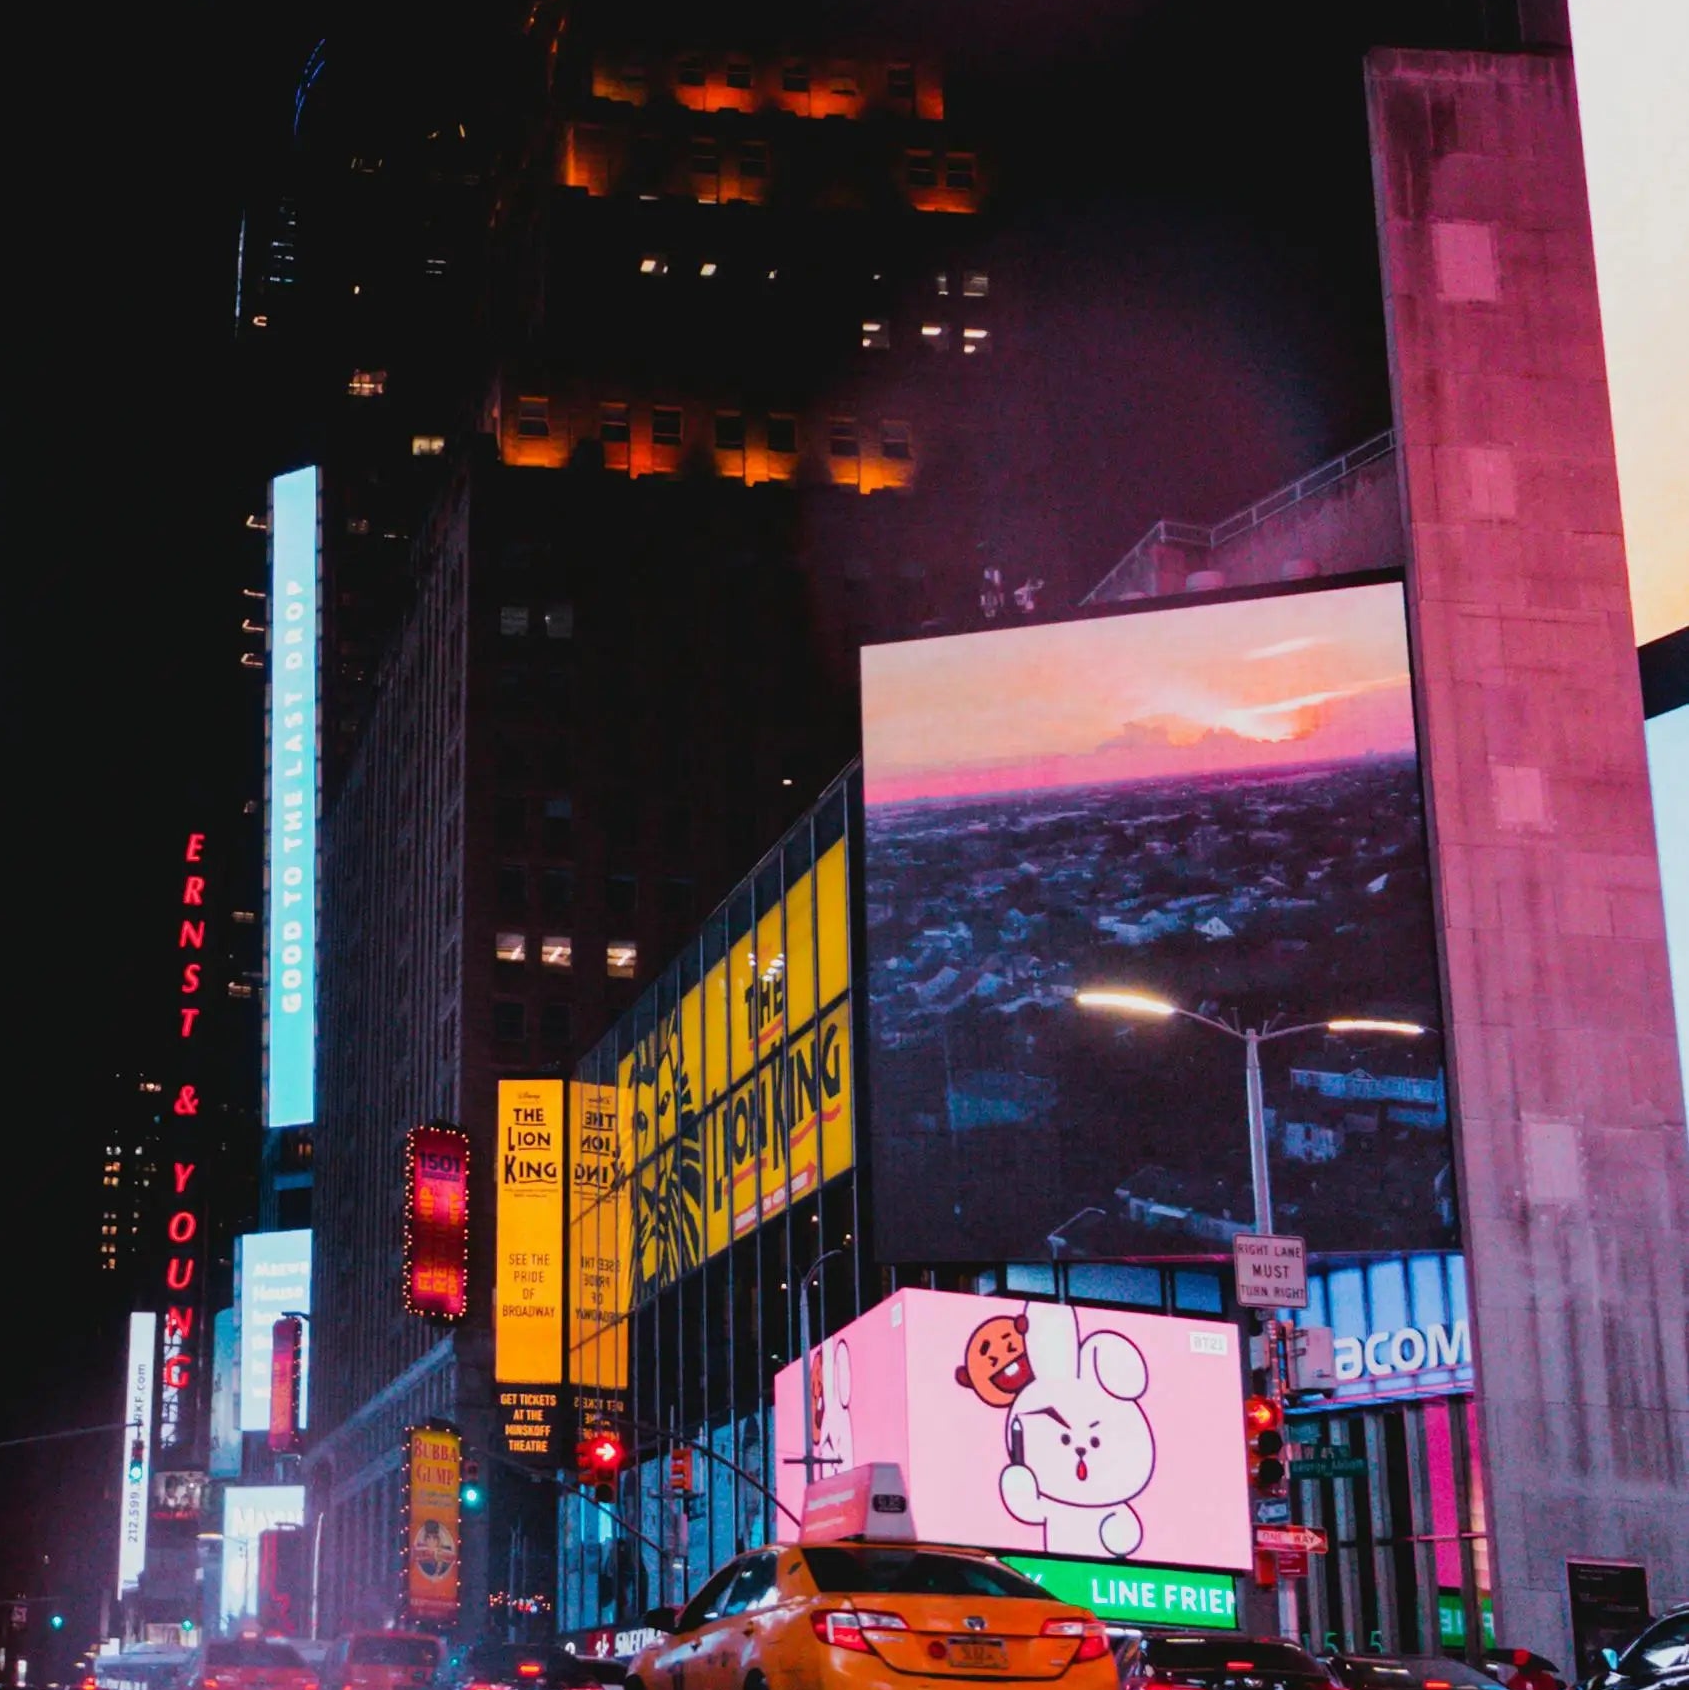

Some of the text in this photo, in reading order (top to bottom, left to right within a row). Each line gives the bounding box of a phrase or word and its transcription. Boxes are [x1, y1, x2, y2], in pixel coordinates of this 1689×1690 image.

[283, 579, 305, 671] DROP
[283, 690, 304, 778] LAST
[282, 789, 304, 855] THE
[283, 865, 304, 909] TO
[162, 832, 206, 1389] ERNST & YOUNG
[513, 1108, 544, 1122] THE
[507, 1126, 551, 1152] LION
[419, 1150, 461, 1174] 1501
[504, 1154, 558, 1184] KING
[1237, 1243, 1302, 1258] RIGHT LANE
[509, 1253, 550, 1266] SEE THE
[513, 1270, 545, 1283] PRIDE
[1252, 1263, 1290, 1279] MUST
[522, 1288, 535, 1300] OF
[1239, 1284, 1305, 1299] TURN RIGHT
[502, 1305, 556, 1318] BROADWAY
[500, 1393, 557, 1406] GET TICKETS
[513, 1409, 543, 1421] AT THE
[505, 1424, 551, 1437] MINSKOFF
[414, 1437, 457, 1463] BUBBA
[509, 1439, 548, 1453] THEATRE
[416, 1463, 455, 1486] GUMP
[1294, 1534, 1315, 1544] WAY
[1091, 1578, 1157, 1608] LINE
